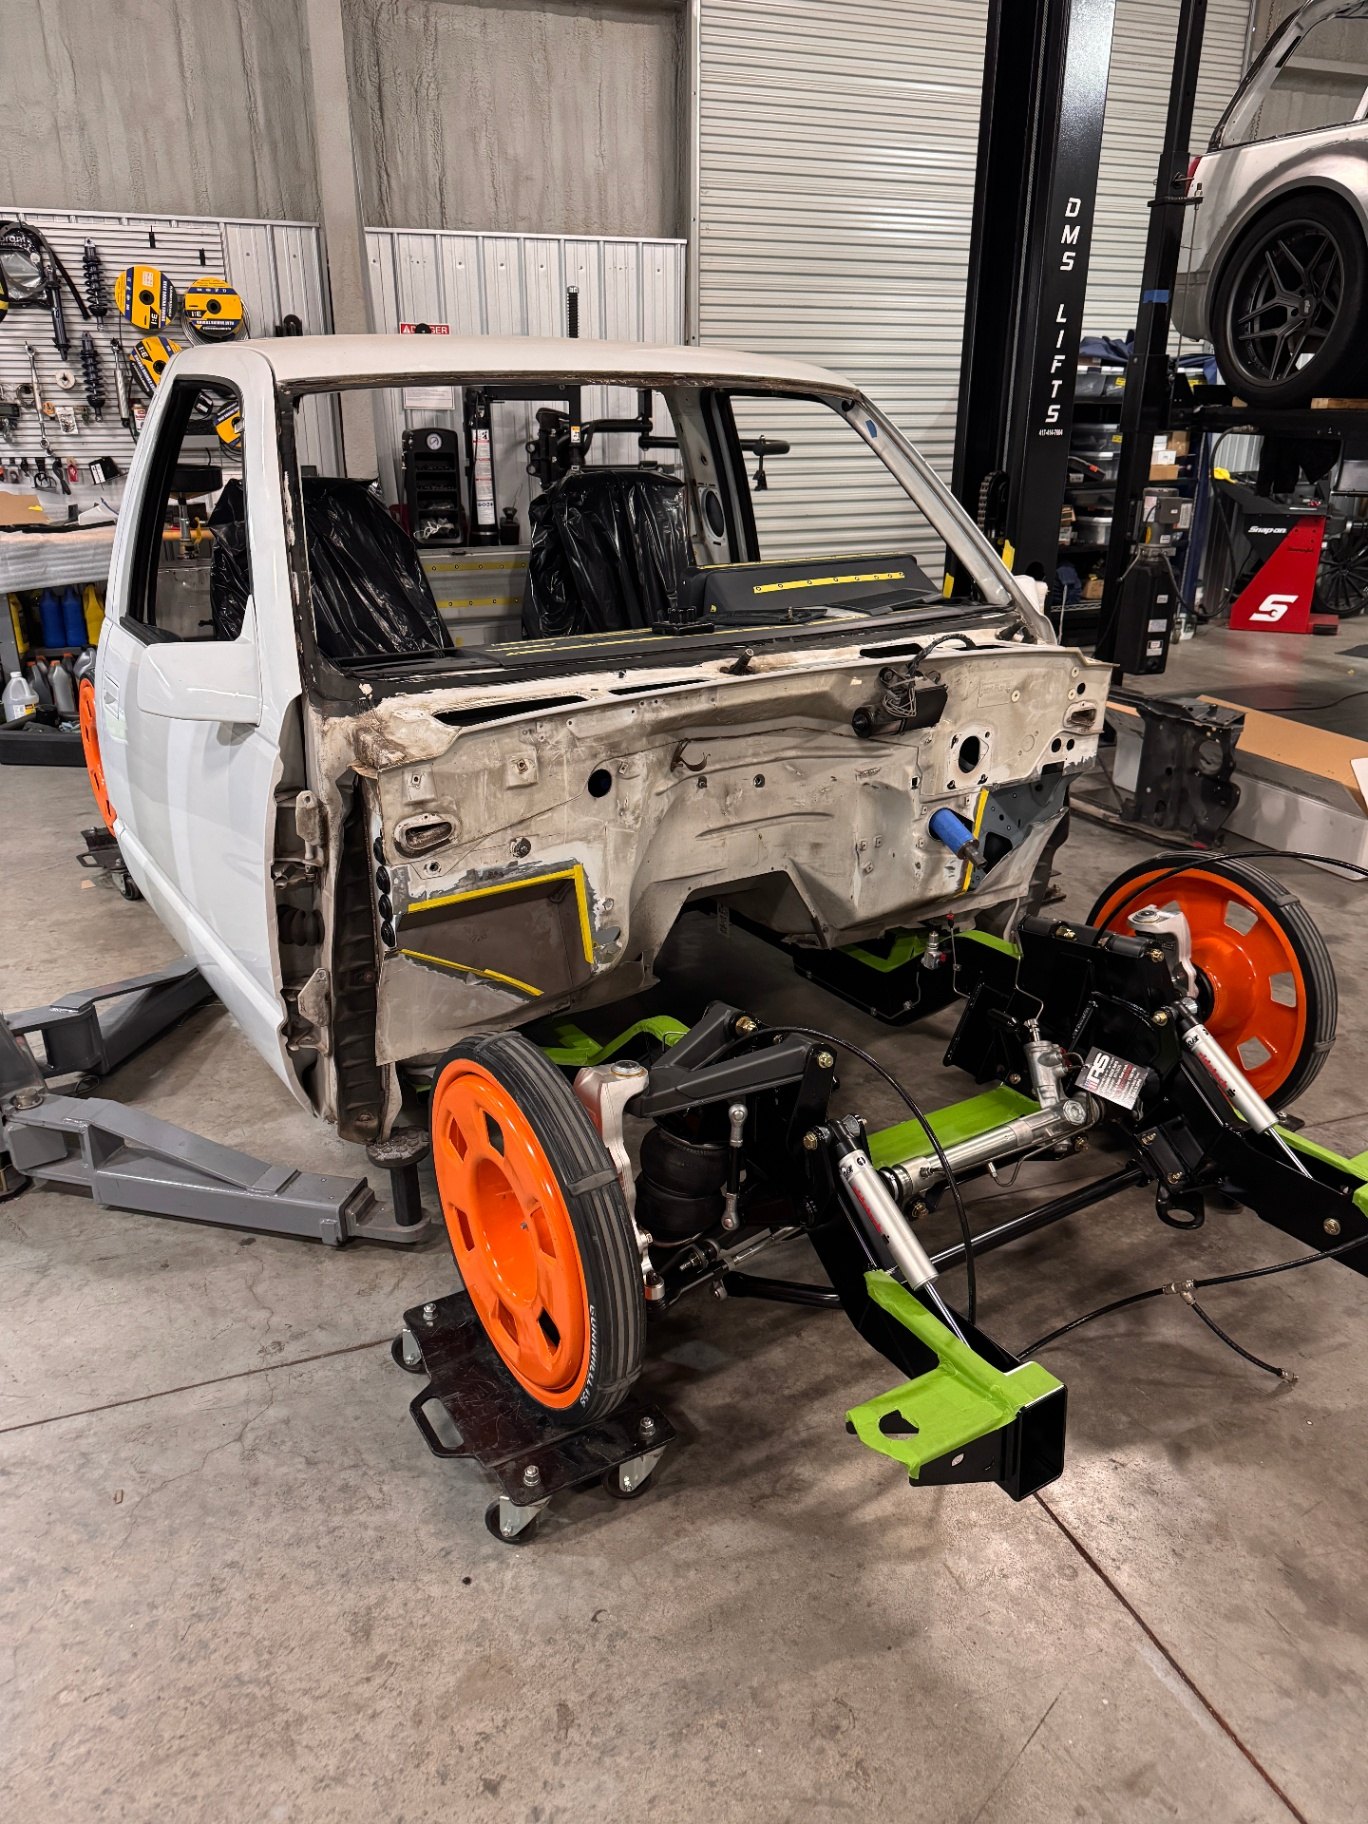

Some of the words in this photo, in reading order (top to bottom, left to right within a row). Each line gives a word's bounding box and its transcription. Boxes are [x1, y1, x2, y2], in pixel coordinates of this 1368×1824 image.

[1059, 197, 1082, 271] DMS
[410, 326, 448, 334] DGER
[1044, 303, 1067, 423] LIFTS
[1247, 525, 1288, 535] Snap-on
